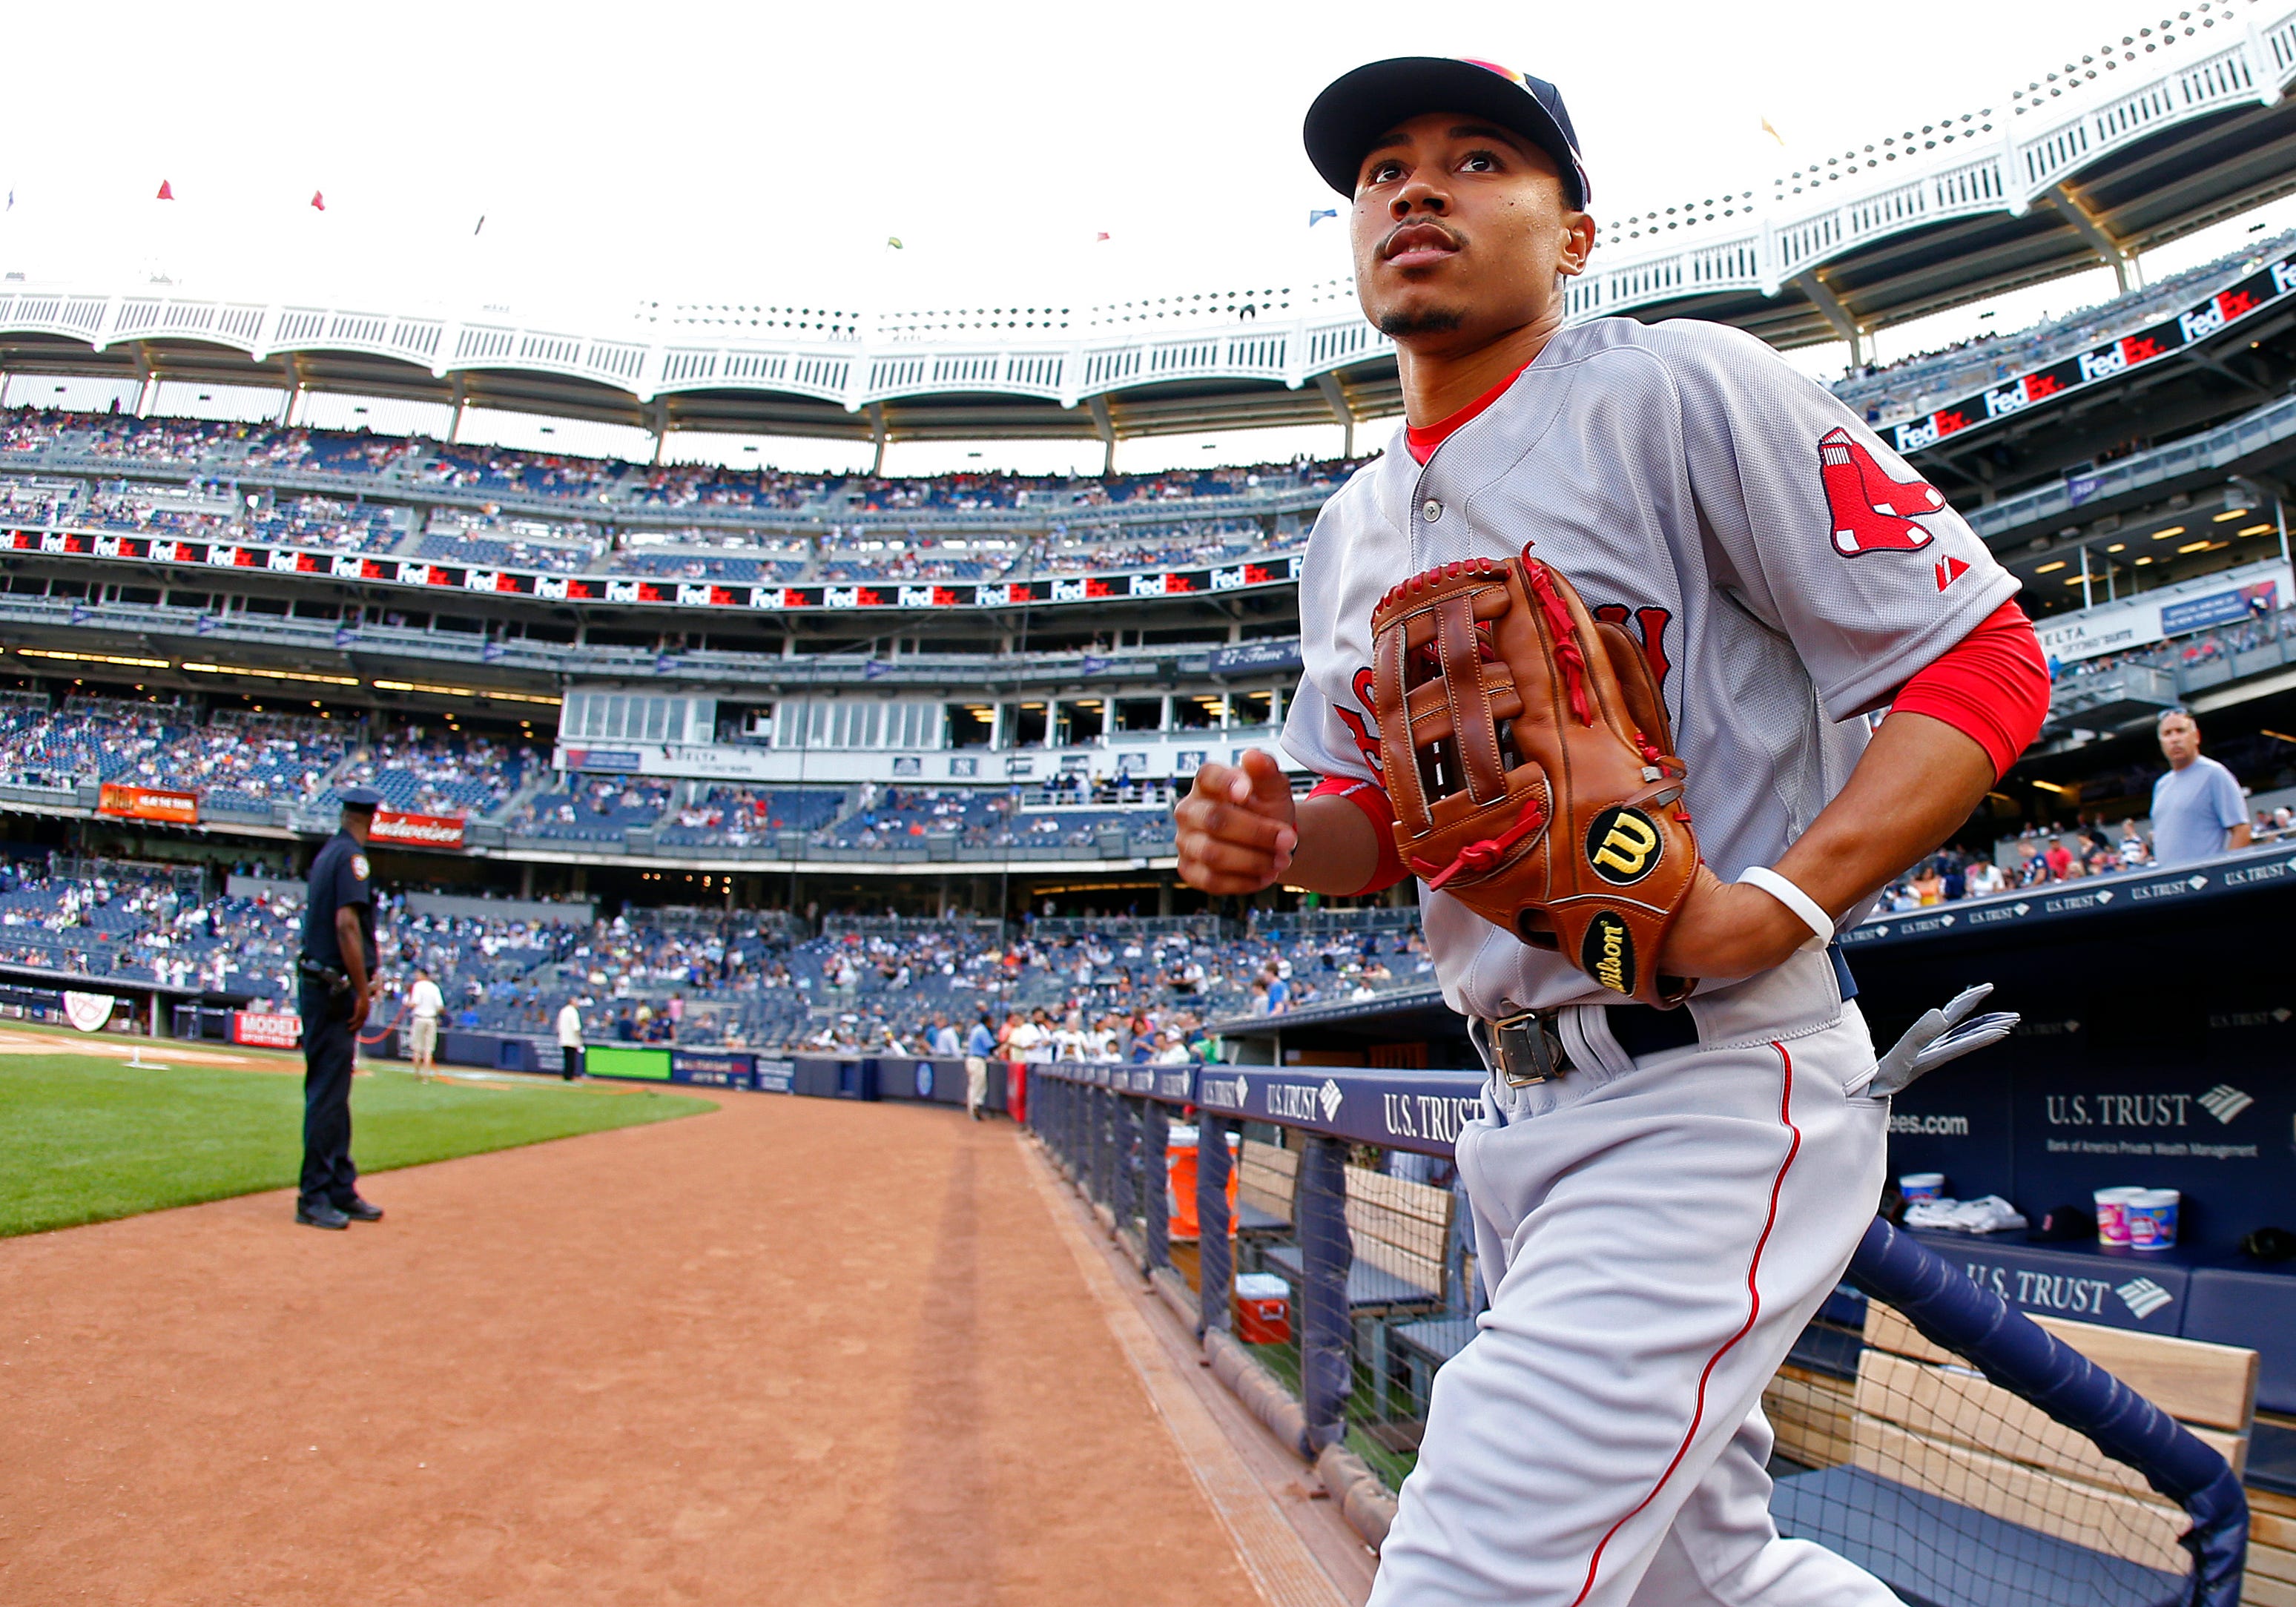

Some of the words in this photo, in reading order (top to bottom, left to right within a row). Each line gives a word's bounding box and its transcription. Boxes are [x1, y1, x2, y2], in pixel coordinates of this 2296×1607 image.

[2179, 291, 2260, 343] FedEx
[2079, 337, 2166, 381] FedEx
[1985, 374, 2065, 418] FedEx
[1895, 410, 1973, 451] FedEx
[1051, 578, 1115, 601] FedEx
[1129, 573, 1197, 596] FedEx
[1210, 564, 1275, 590] FedEx
[1592, 812, 1656, 874] W
[2152, 880, 2187, 897] TRUST
[2246, 862, 2286, 882] TRUST
[1384, 1094, 1417, 1137] U.S.
[1890, 1115, 1969, 1135] ees.com
[2046, 1095, 2093, 1126] U.S.
[2097, 1094, 2191, 1126] TRUST
[2016, 1270, 2111, 1314] TRUST
